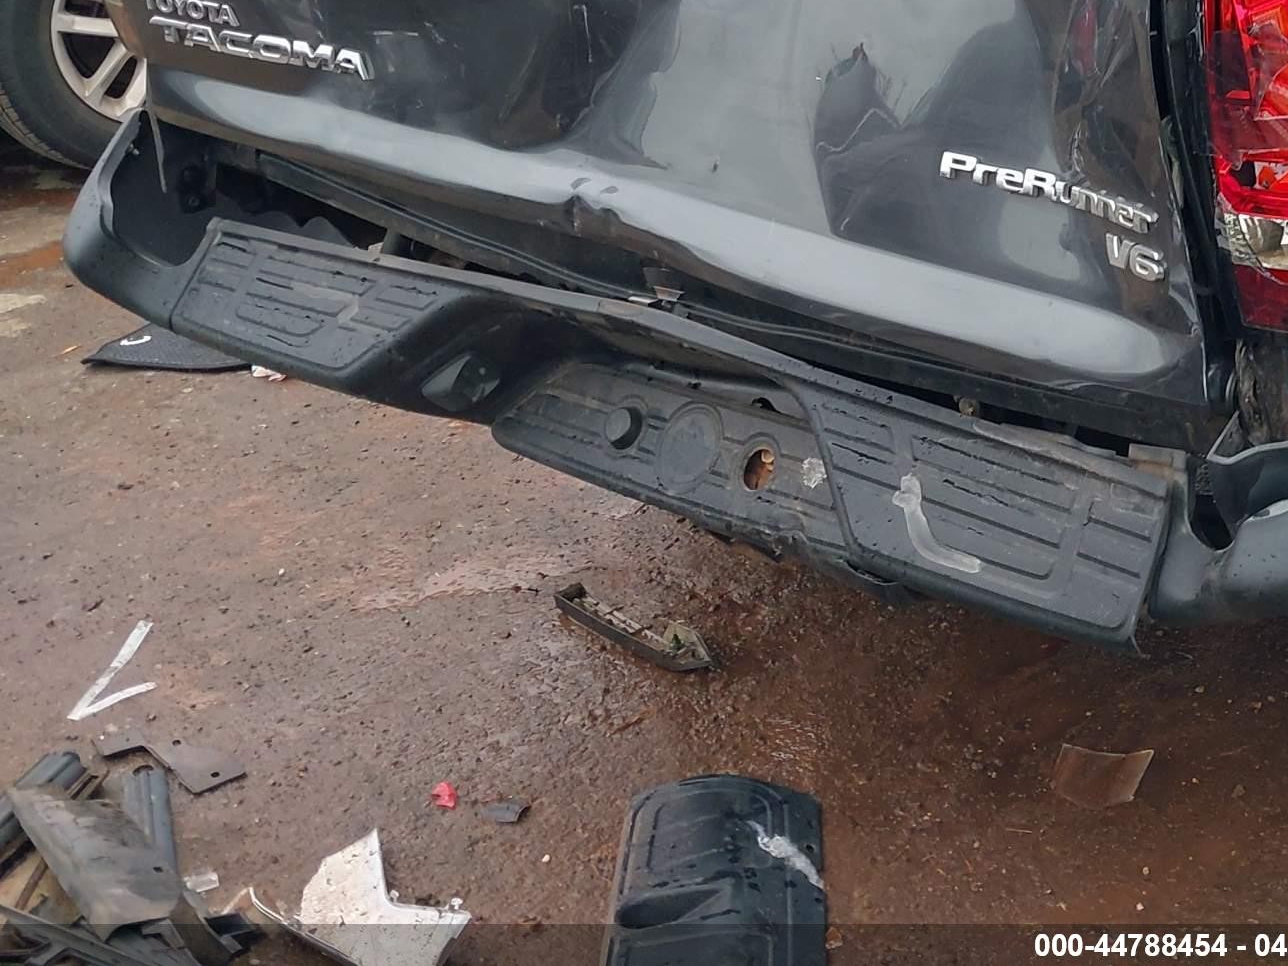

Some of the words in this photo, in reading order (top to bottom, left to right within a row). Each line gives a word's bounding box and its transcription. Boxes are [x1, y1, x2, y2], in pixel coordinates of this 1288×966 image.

[149, 15, 375, 81] TACOMA
[939, 151, 1160, 234] PreRunner
[1105, 232, 1168, 282] V6
